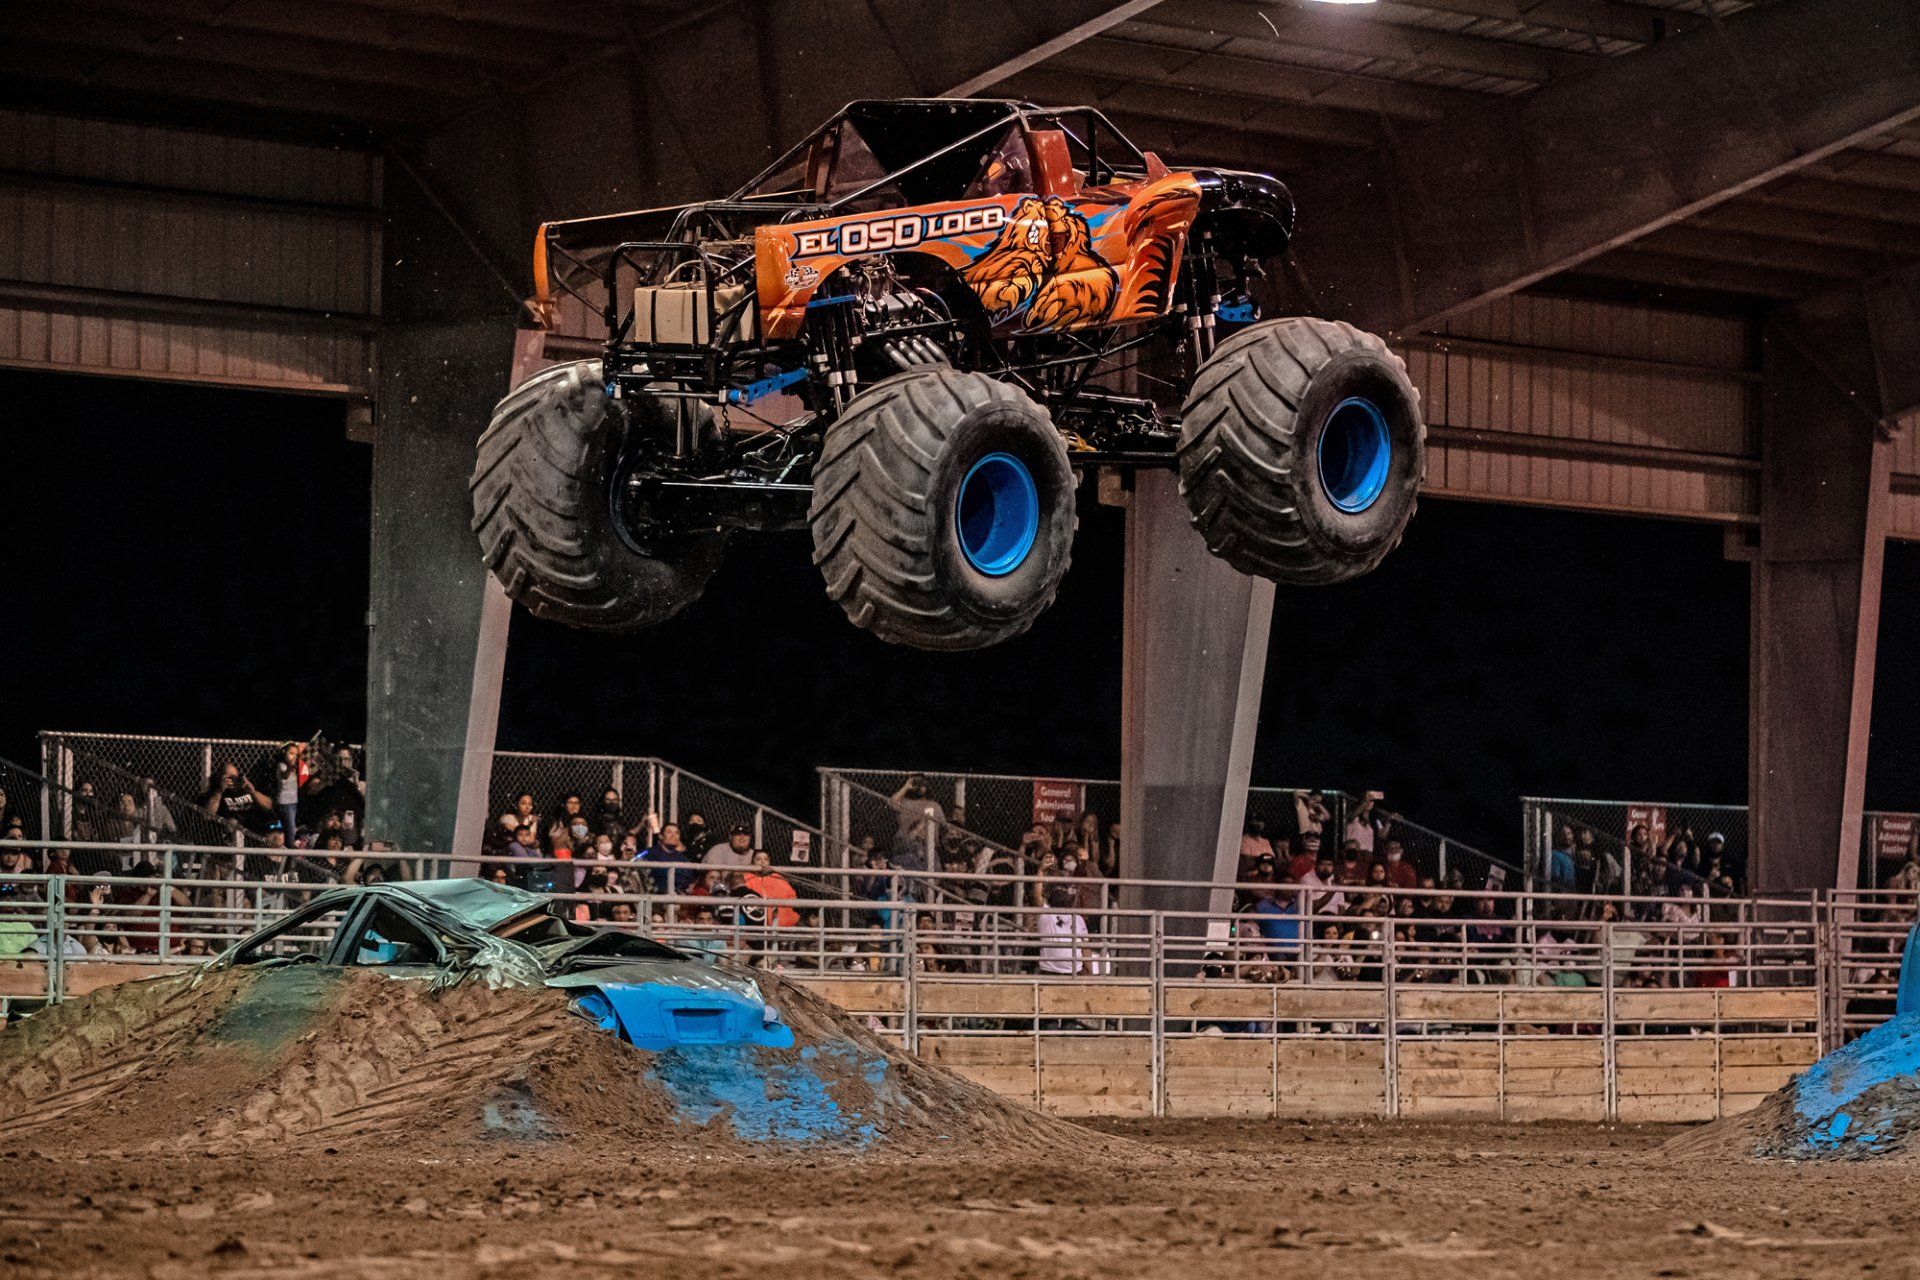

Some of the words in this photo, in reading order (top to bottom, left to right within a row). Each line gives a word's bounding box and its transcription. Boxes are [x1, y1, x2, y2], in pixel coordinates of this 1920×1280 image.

[798, 230, 838, 256] EL
[841, 215, 922, 255] OSO
[926, 206, 1004, 239] LOCO
[1040, 786, 1072, 798] General
[1036, 799, 1075, 811] Admission
